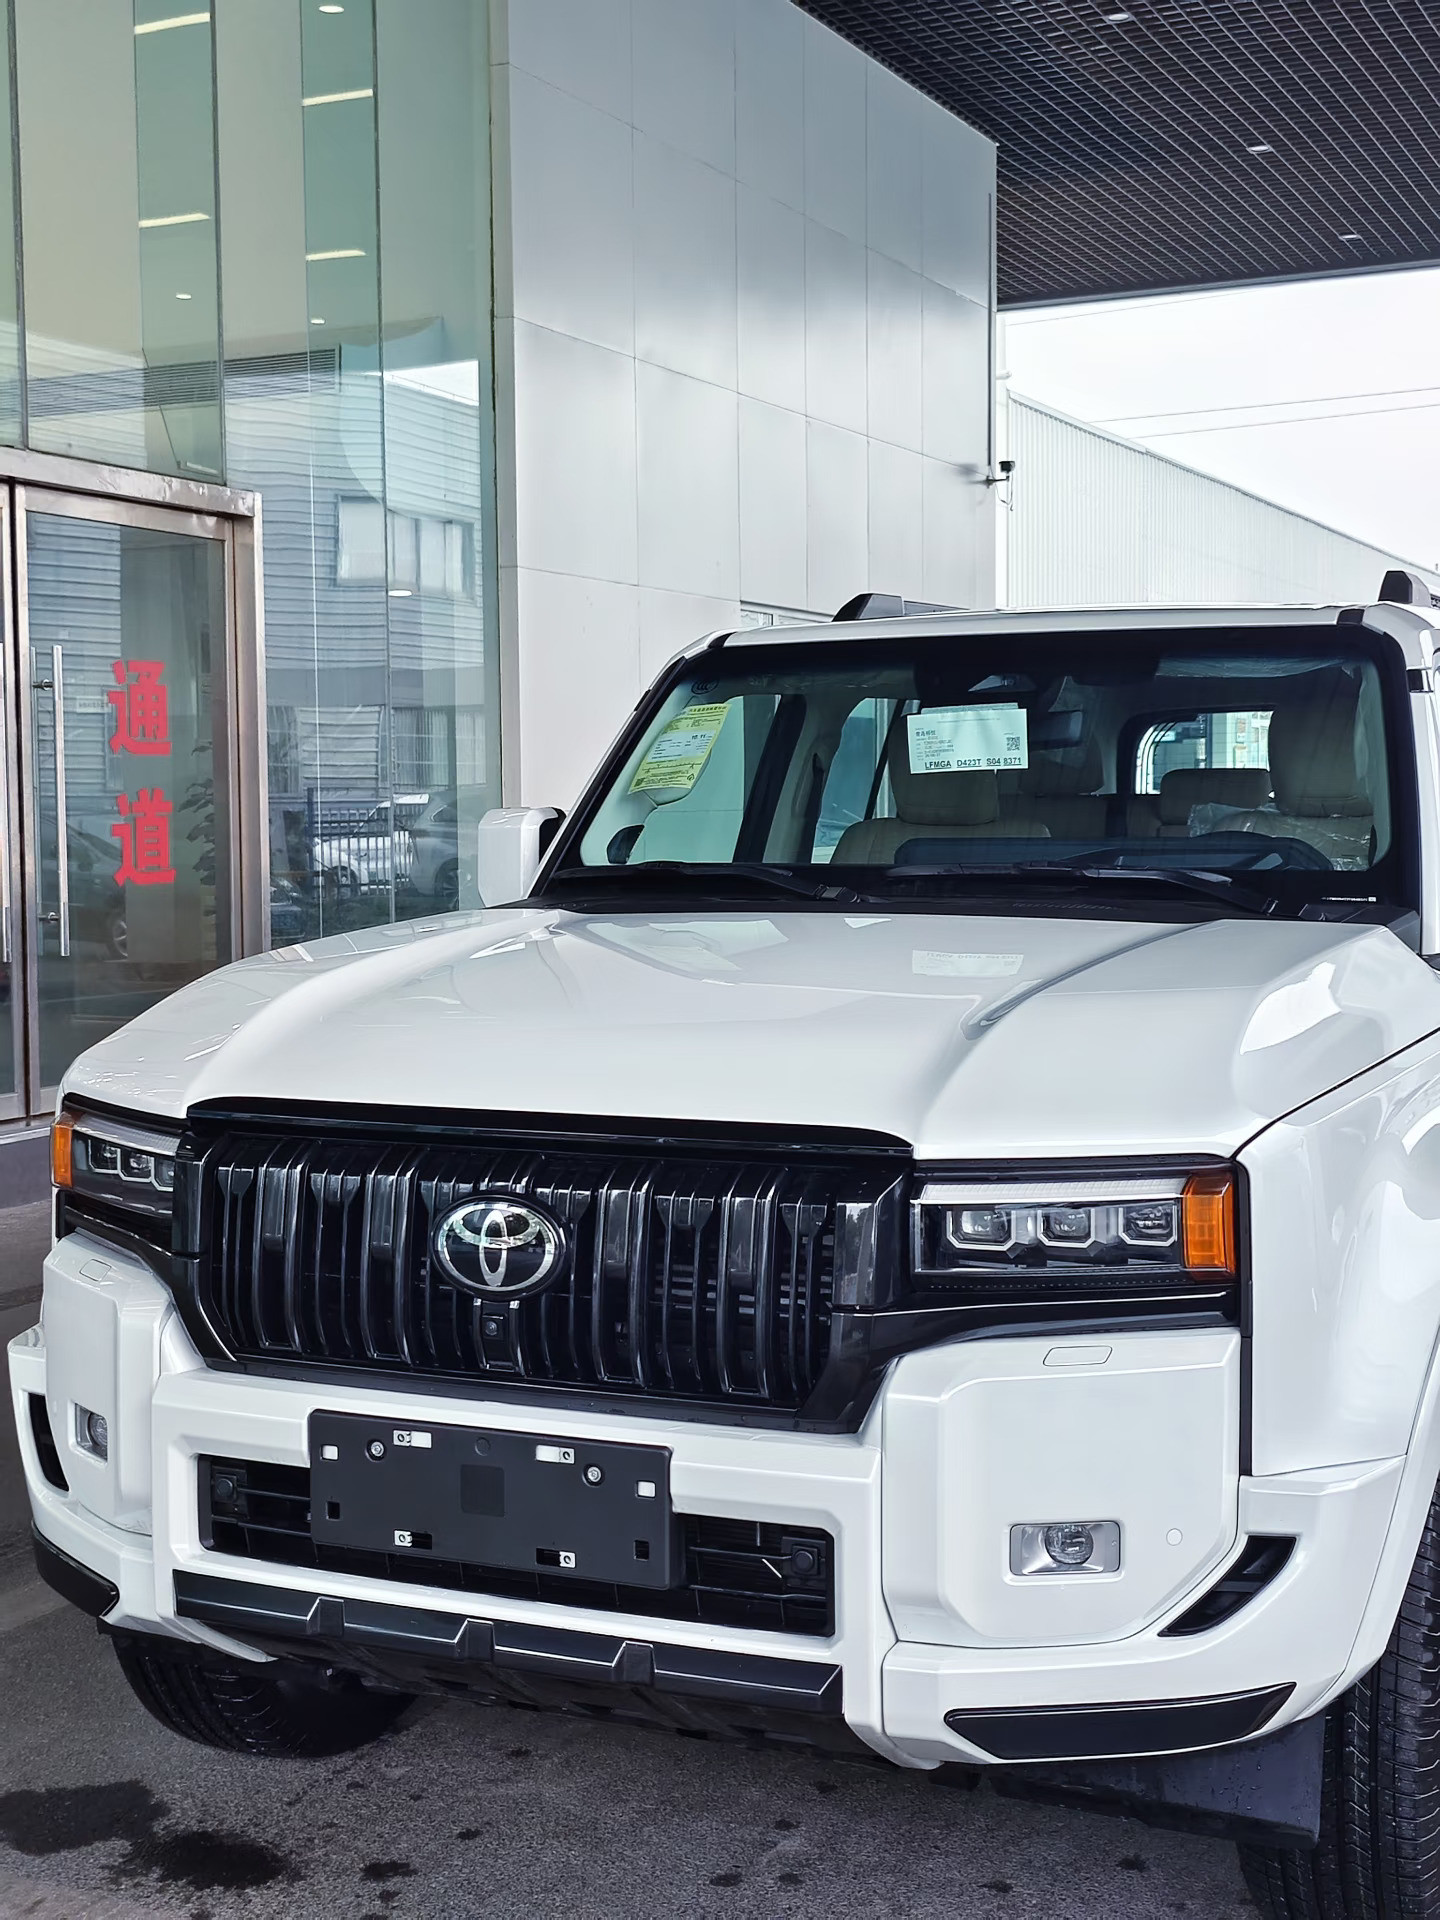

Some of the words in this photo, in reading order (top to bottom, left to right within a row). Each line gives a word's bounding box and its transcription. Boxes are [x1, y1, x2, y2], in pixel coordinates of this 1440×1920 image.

[108, 660, 176, 886] 通道
[925, 761, 951, 769] LFMGA
[957, 759, 981, 767] D423T
[1003, 757, 1021, 765] 8371
